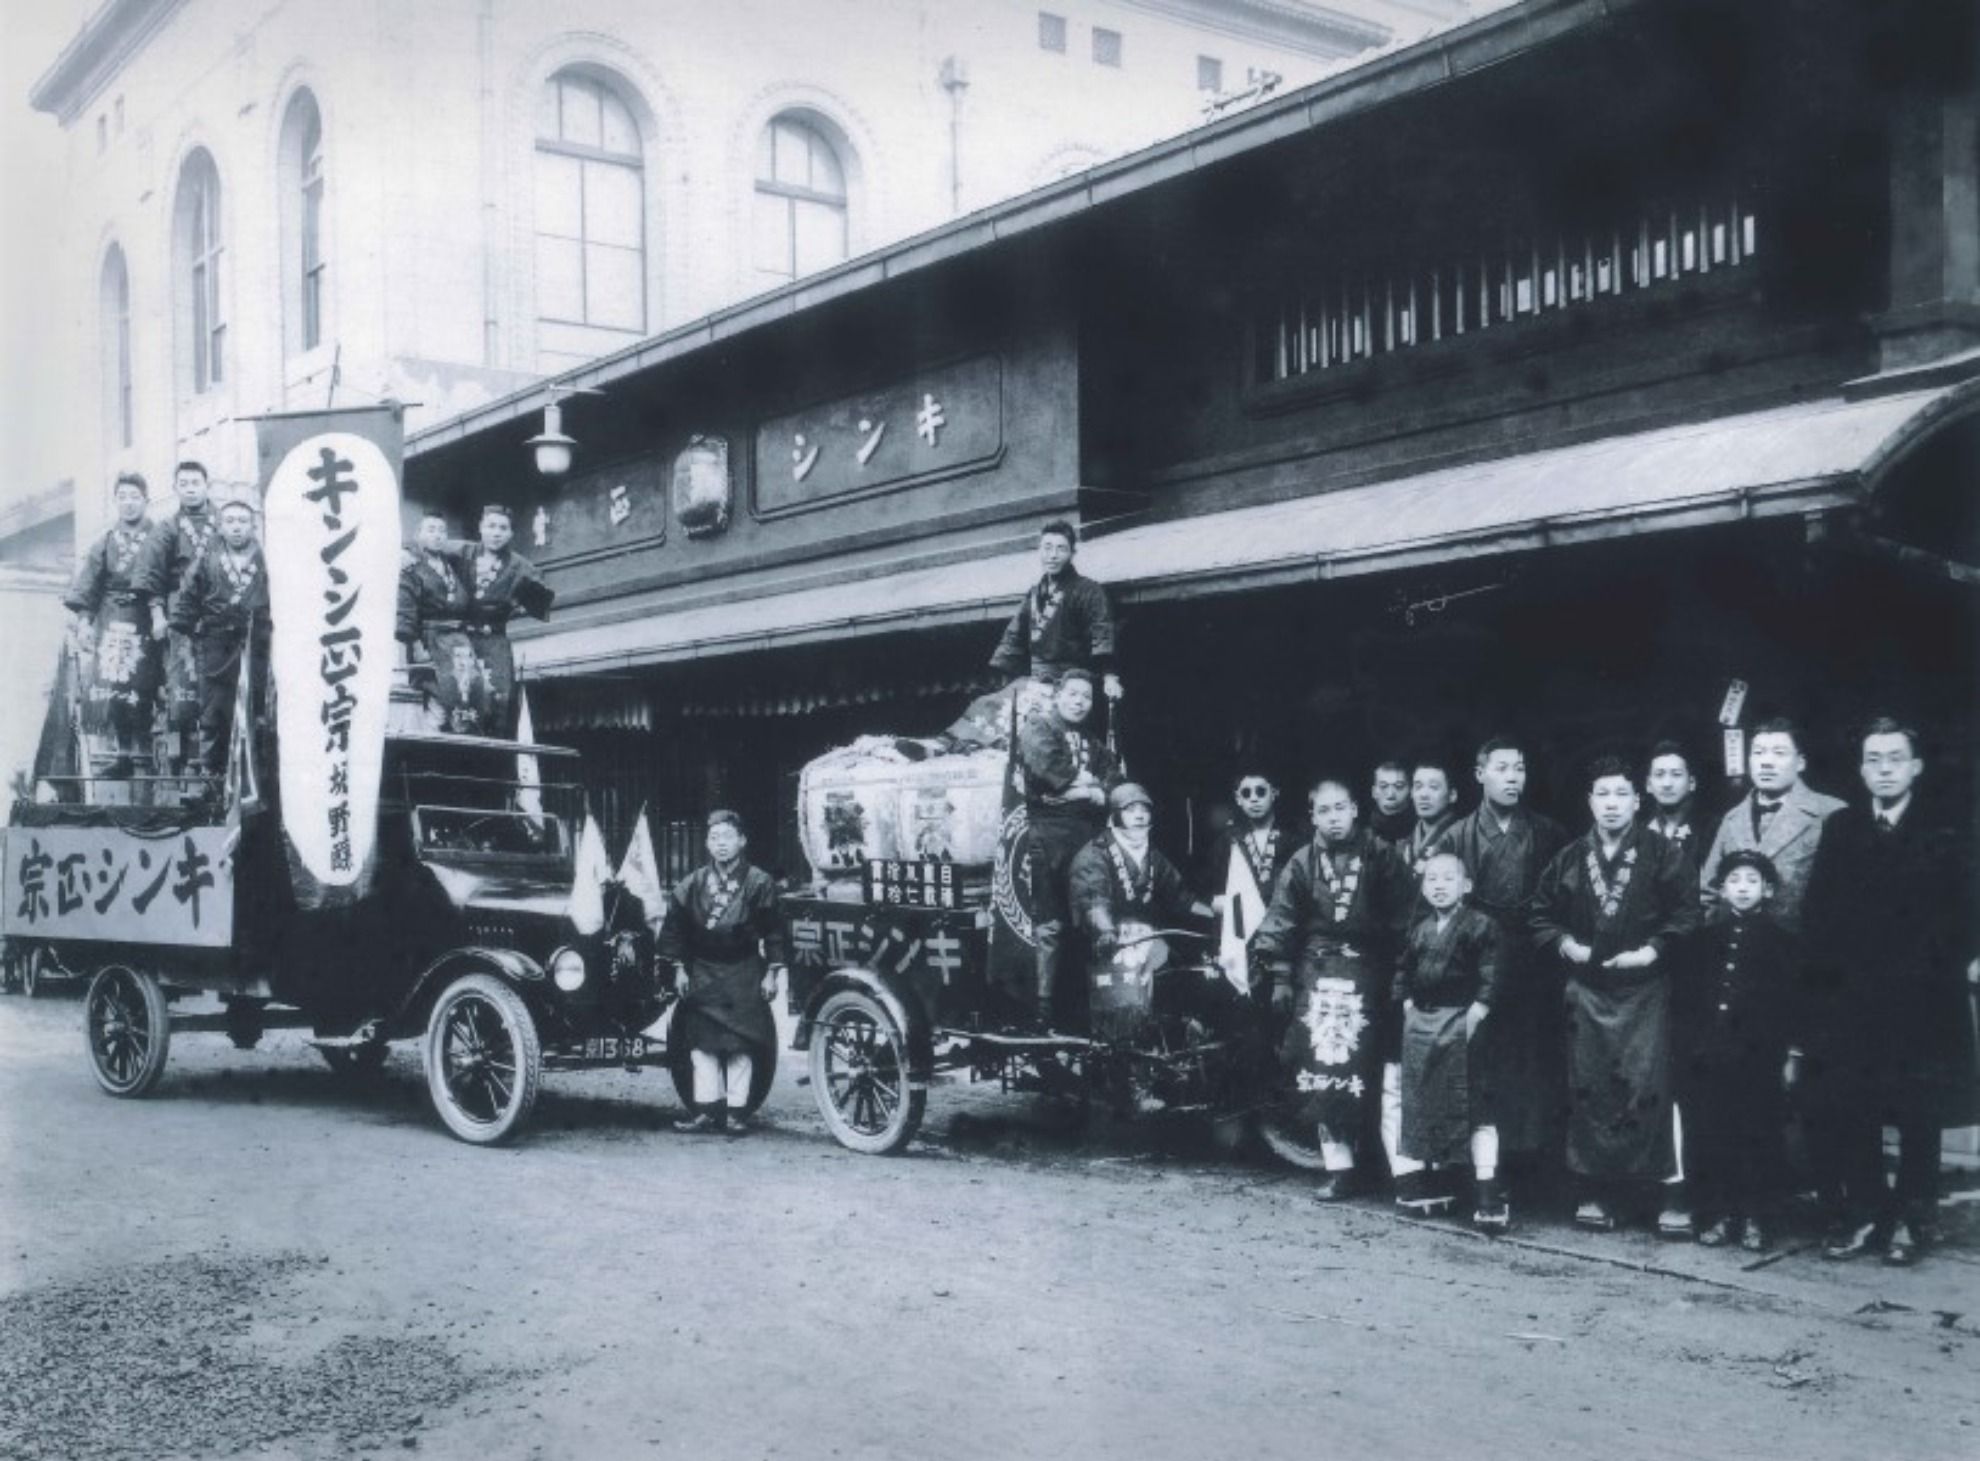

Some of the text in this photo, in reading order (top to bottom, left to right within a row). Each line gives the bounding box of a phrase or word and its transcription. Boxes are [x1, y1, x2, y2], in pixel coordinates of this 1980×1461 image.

[305, 447, 362, 753] キンシ正宗
[17, 836, 215, 930] キンシ正宗
[793, 917, 962, 986] キンシ正宗
